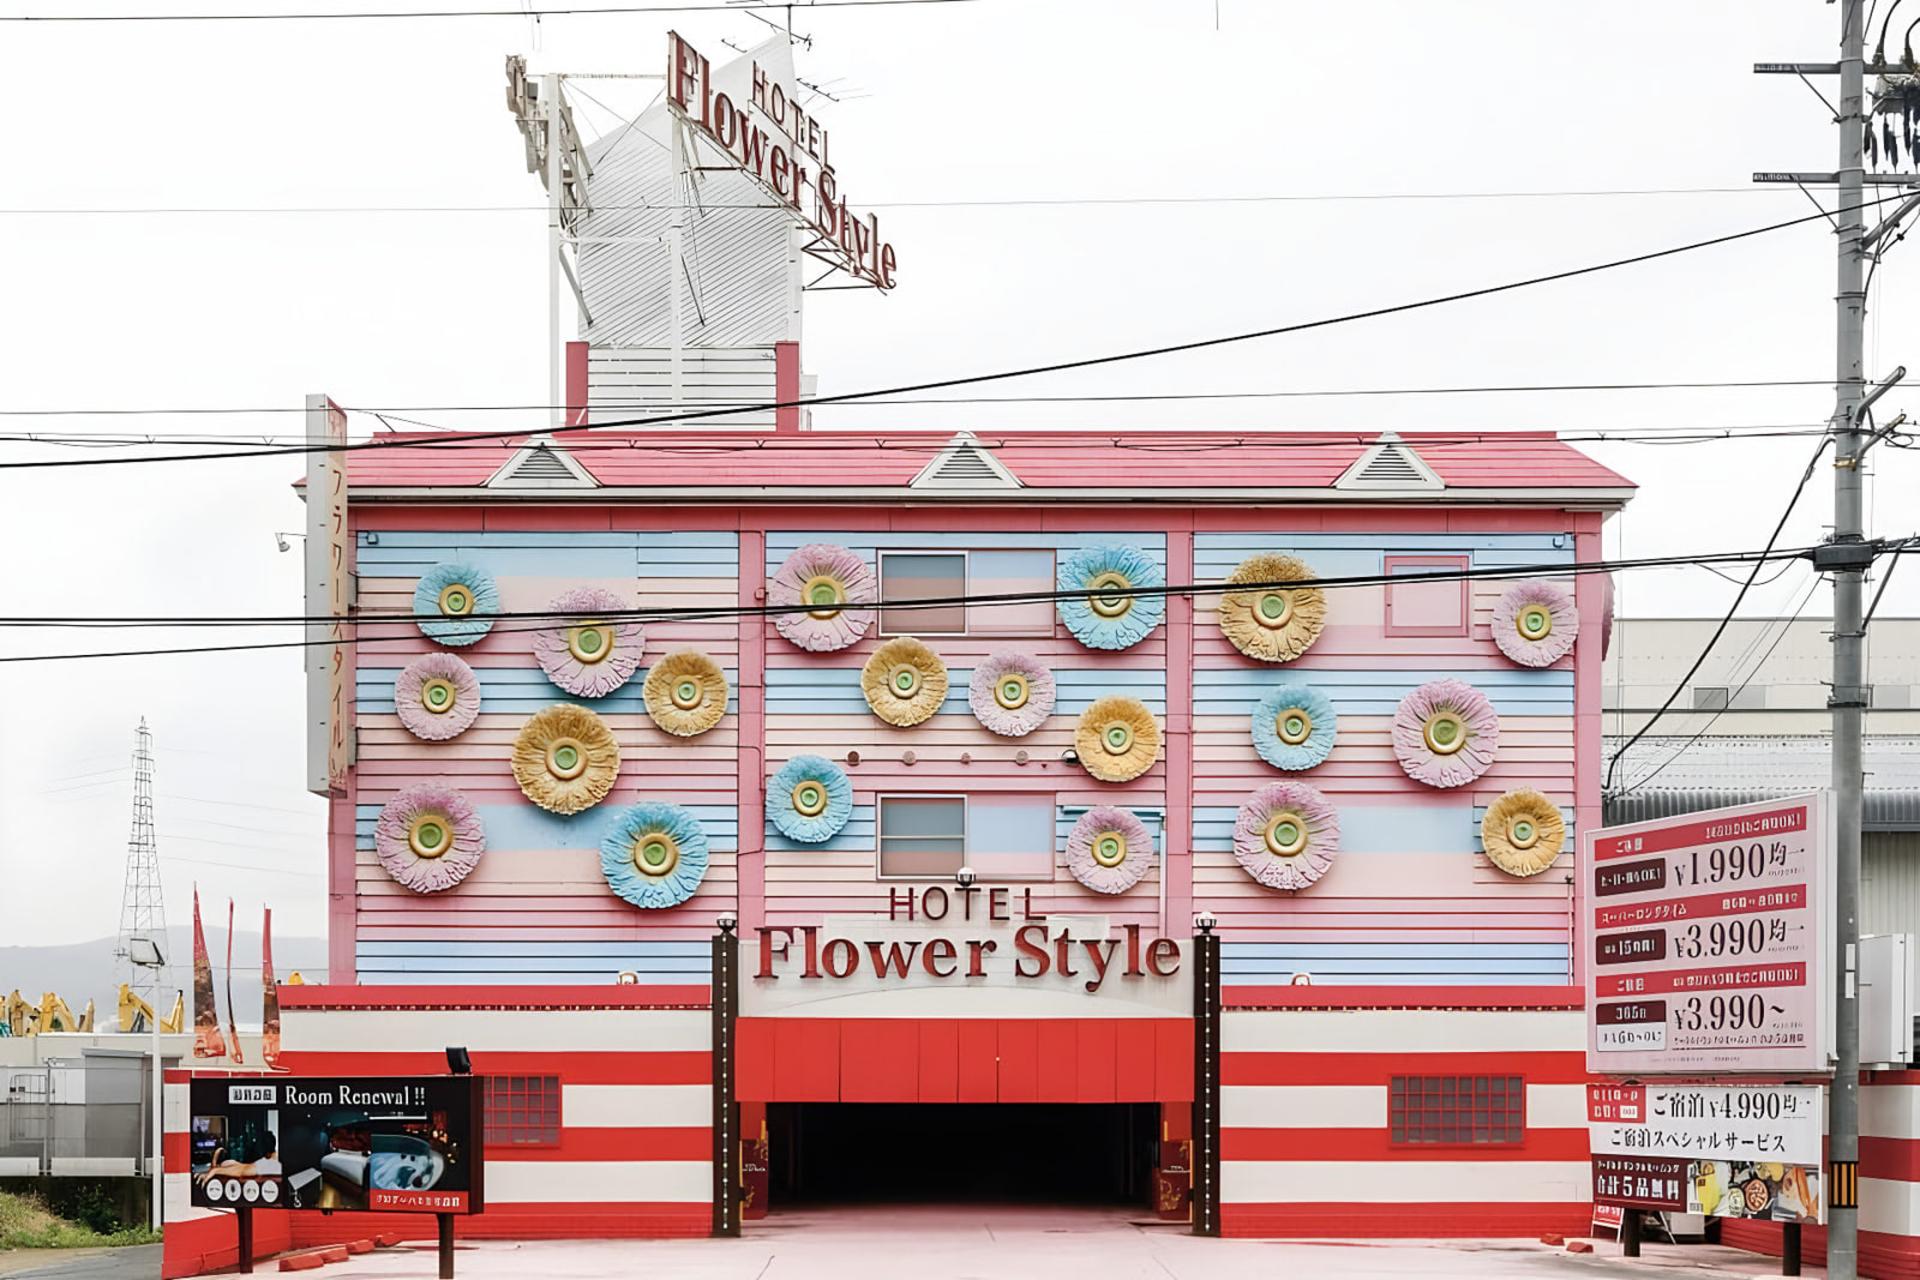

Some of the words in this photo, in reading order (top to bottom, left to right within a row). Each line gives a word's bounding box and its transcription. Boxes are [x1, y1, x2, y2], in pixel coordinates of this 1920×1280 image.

[752, 60, 834, 172] HOTEL
[667, 29, 806, 212] Flower
[817, 168, 897, 289] Style
[889, 886, 1047, 921] HOTEL
[753, 924, 998, 979] Flower
[1014, 923, 1181, 993] Style
[285, 1085, 333, 1104] Room
[339, 1085, 409, 1105] Renewal
